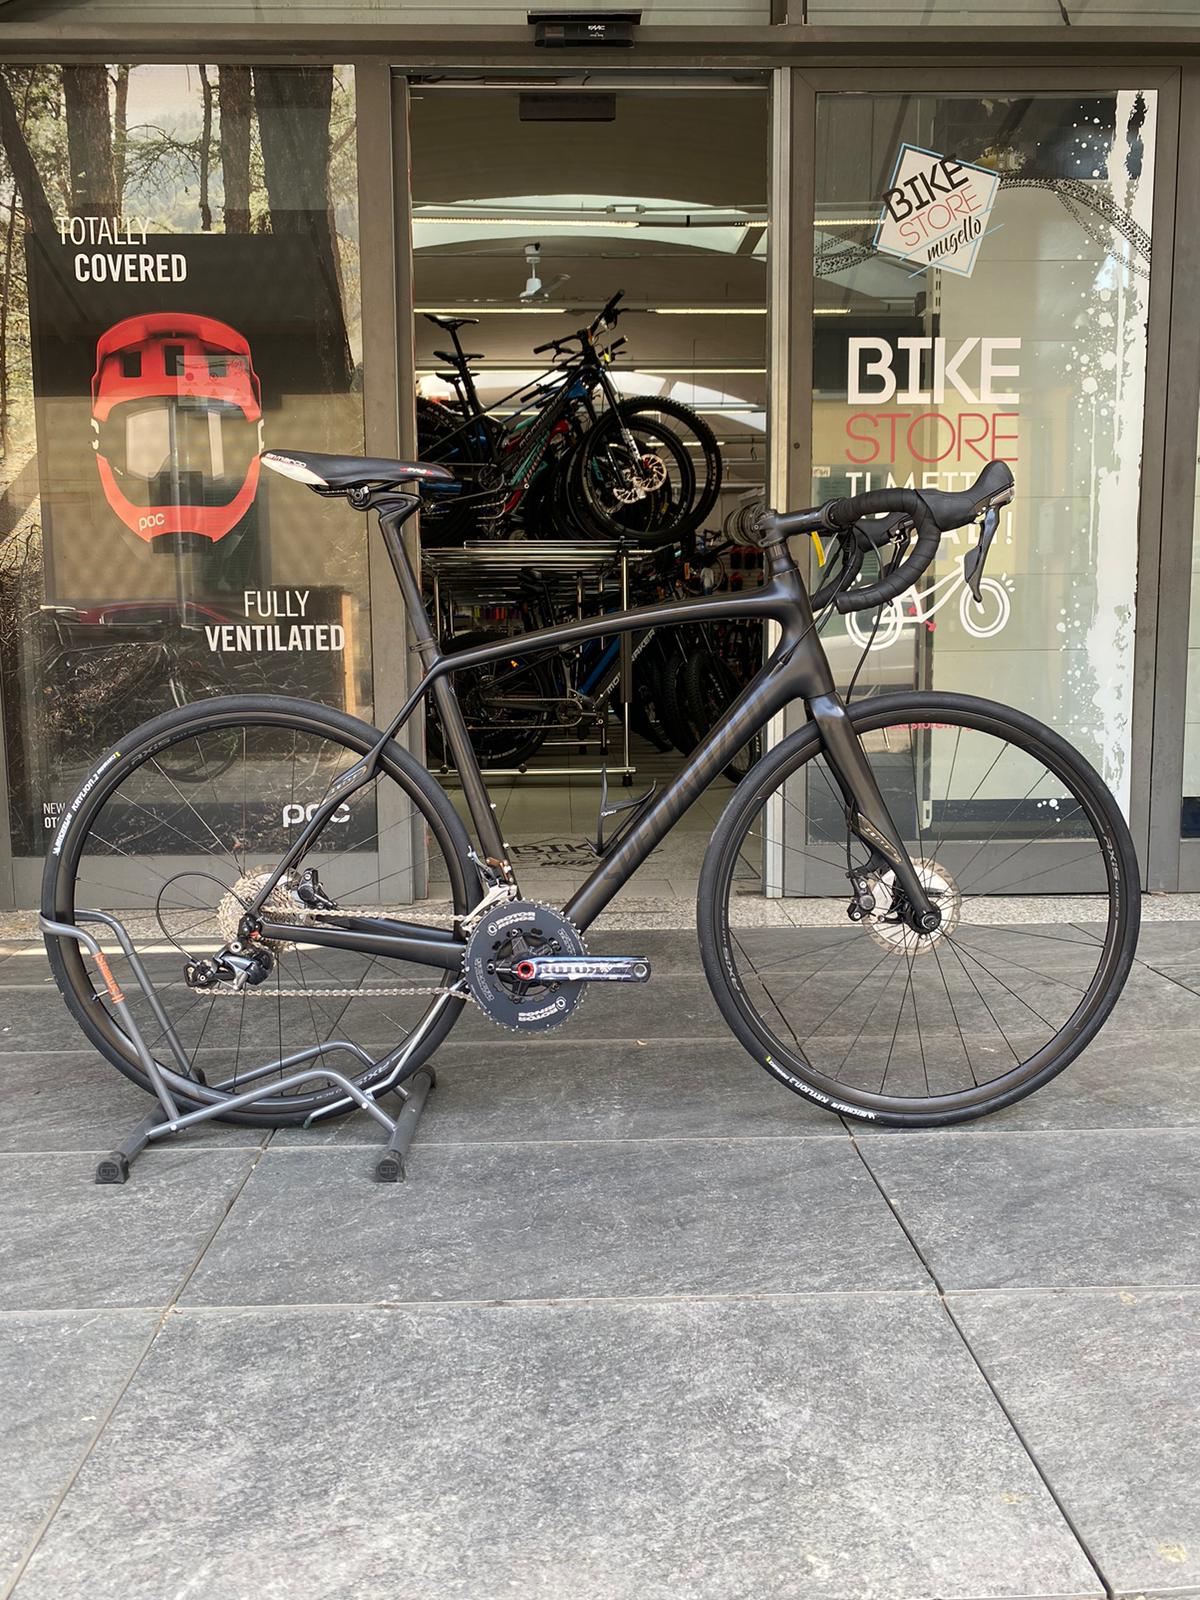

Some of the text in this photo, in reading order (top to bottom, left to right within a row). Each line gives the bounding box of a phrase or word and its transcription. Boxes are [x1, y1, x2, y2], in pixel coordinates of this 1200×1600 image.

[882, 152, 969, 223] BIKE
[55, 216, 150, 245] TOTALLY
[899, 184, 982, 246] STORE
[927, 215, 981, 262] mugello
[74, 253, 188, 282] COVERED
[847, 336, 1021, 405] BIKE
[844, 412, 1020, 464] STORE
[243, 590, 310, 618] FULLY
[204, 624, 346, 651] VENTILATED
